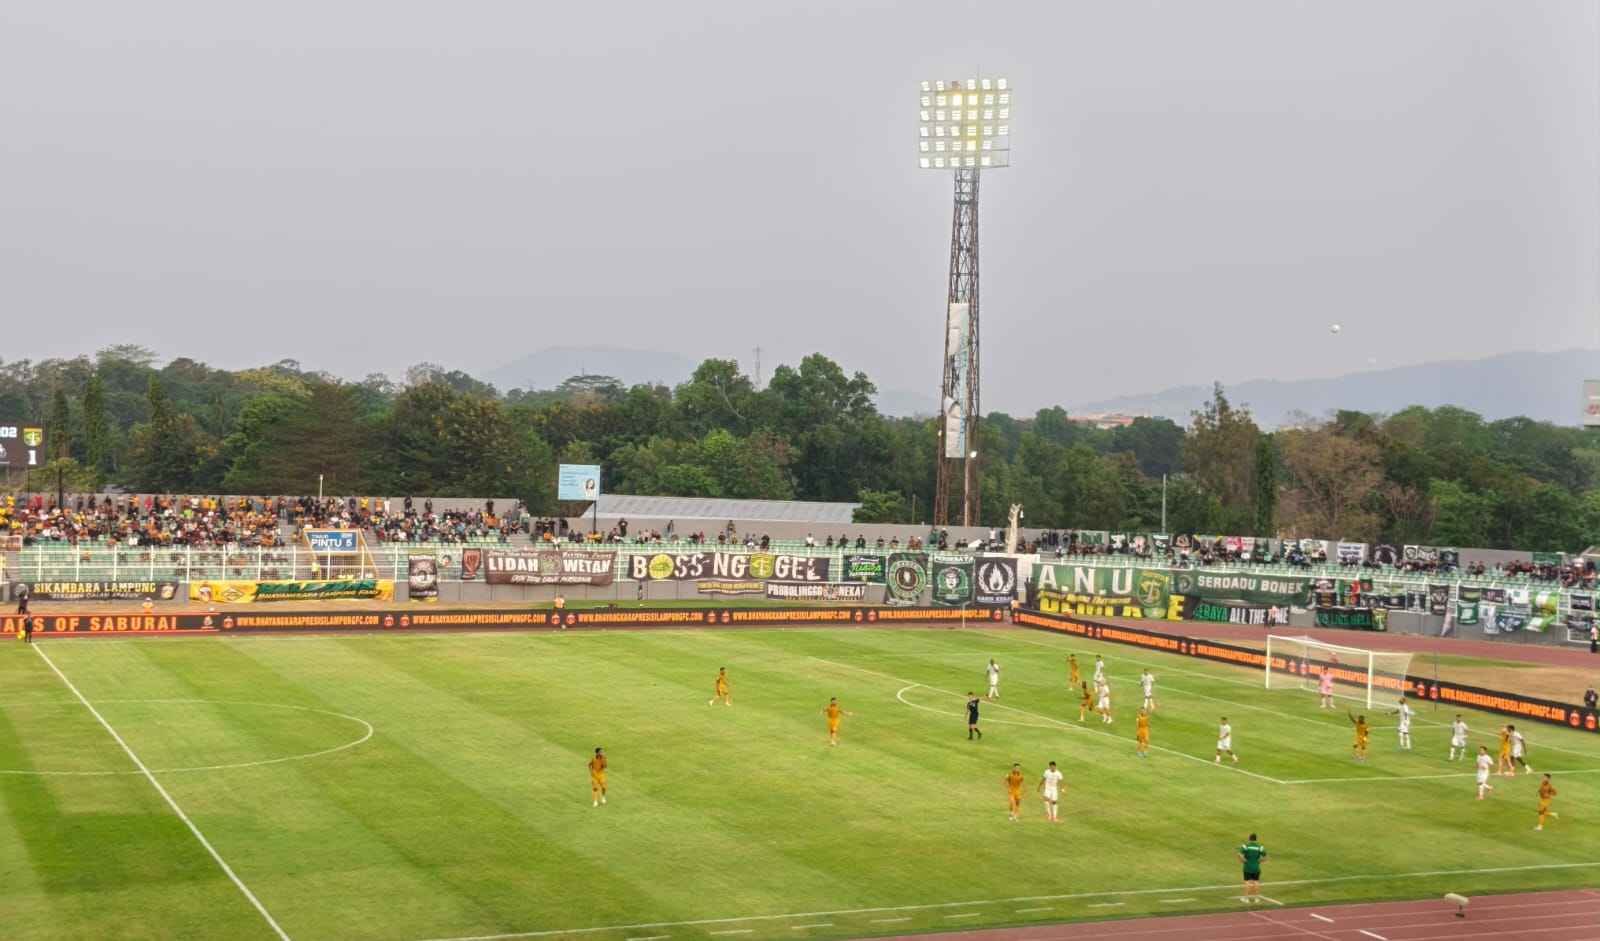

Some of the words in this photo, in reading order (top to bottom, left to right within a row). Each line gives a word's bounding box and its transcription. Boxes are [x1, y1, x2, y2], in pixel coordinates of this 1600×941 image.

[28, 450, 37, 465] 1
[311, 538, 342, 548] PINTU
[488, 558, 539, 572] LIDAH
[563, 559, 611, 573] WETAN
[34, 582, 100, 593] SIKAMBARA
[104, 582, 156, 593] LAMPUNG
[1229, 607, 1249, 624] ALL
[1248, 608, 1267, 624] THE
[55, 617, 80, 631] OF
[90, 616, 177, 631] SABURAI
